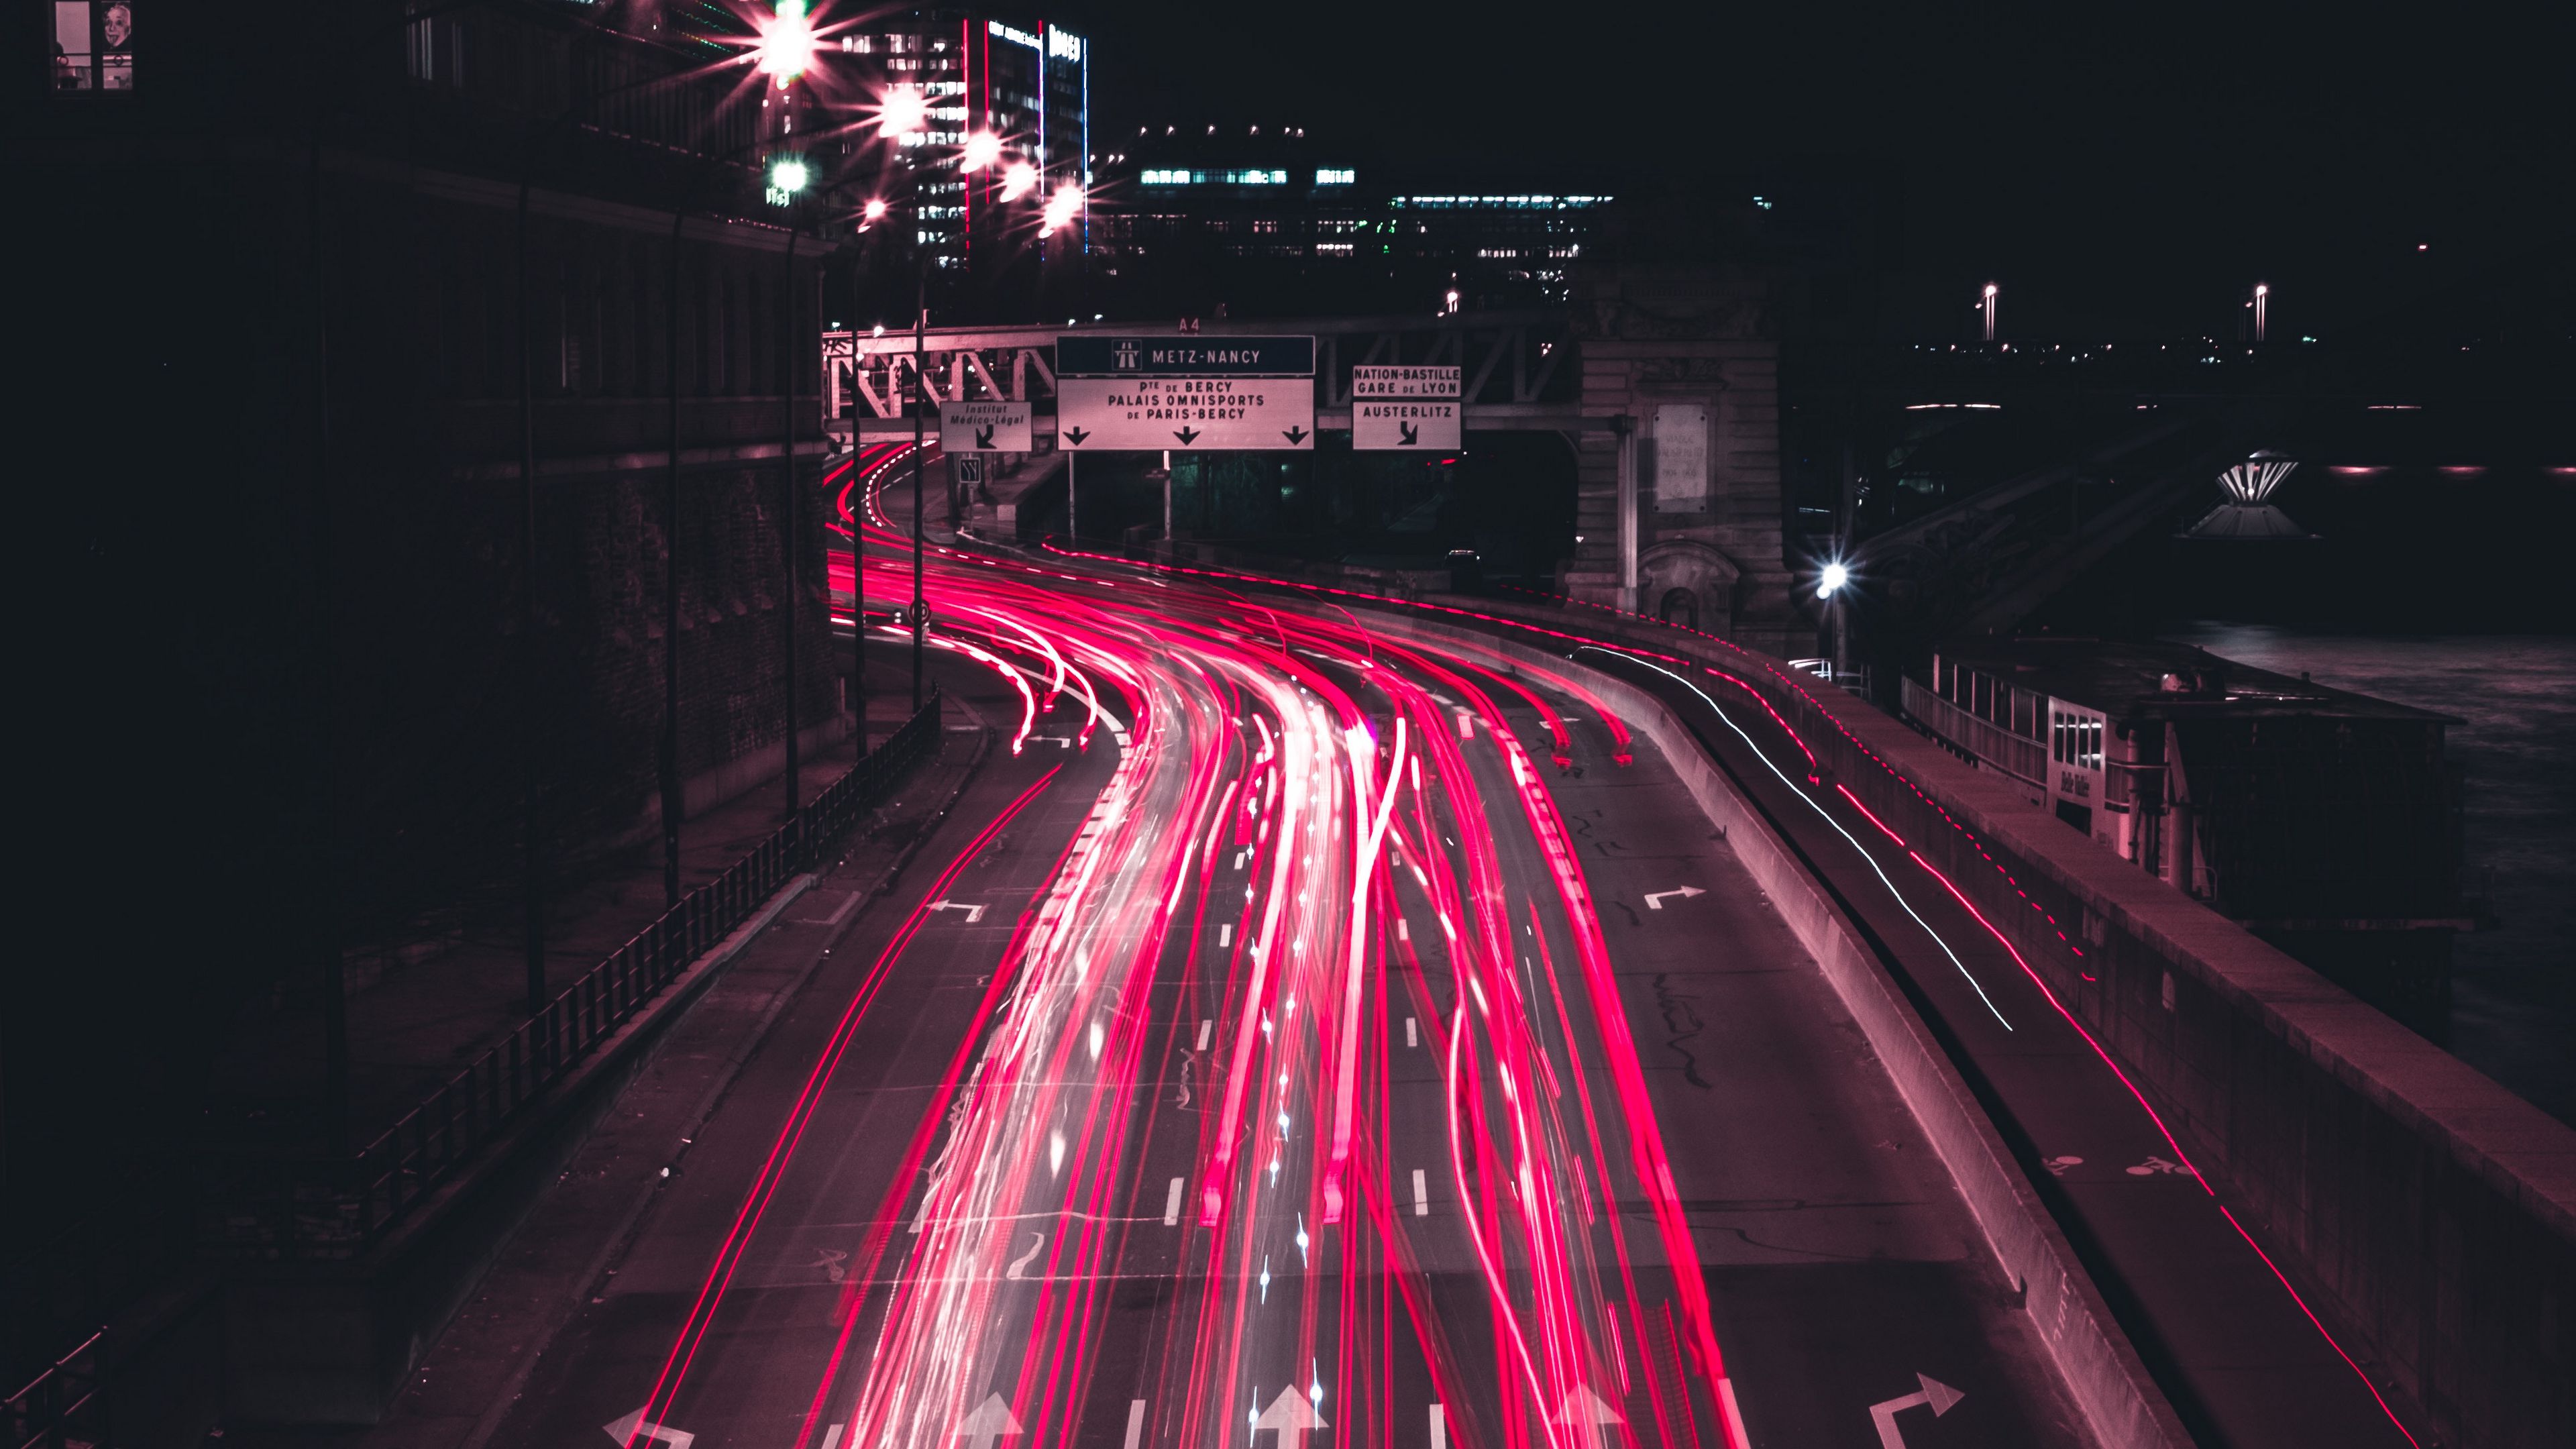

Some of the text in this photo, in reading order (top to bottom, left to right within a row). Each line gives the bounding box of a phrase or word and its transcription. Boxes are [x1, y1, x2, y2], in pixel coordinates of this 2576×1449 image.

[1152, 350, 1260, 364] METZ-NANCY
[1354, 368, 1460, 380] NATION-BASTILLE
[1185, 381, 1232, 392] BERCY
[1358, 382, 1395, 394] GARE
[1421, 382, 1456, 394] LYON
[1108, 394, 1265, 407] PALAIS OMNISPORTS
[965, 404, 1008, 414] Institut
[1146, 408, 1245, 419] PARIS-BERCY
[1362, 406, 1452, 417] AUSTERLITZ
[950, 414, 1024, 426] Médico-Légal
